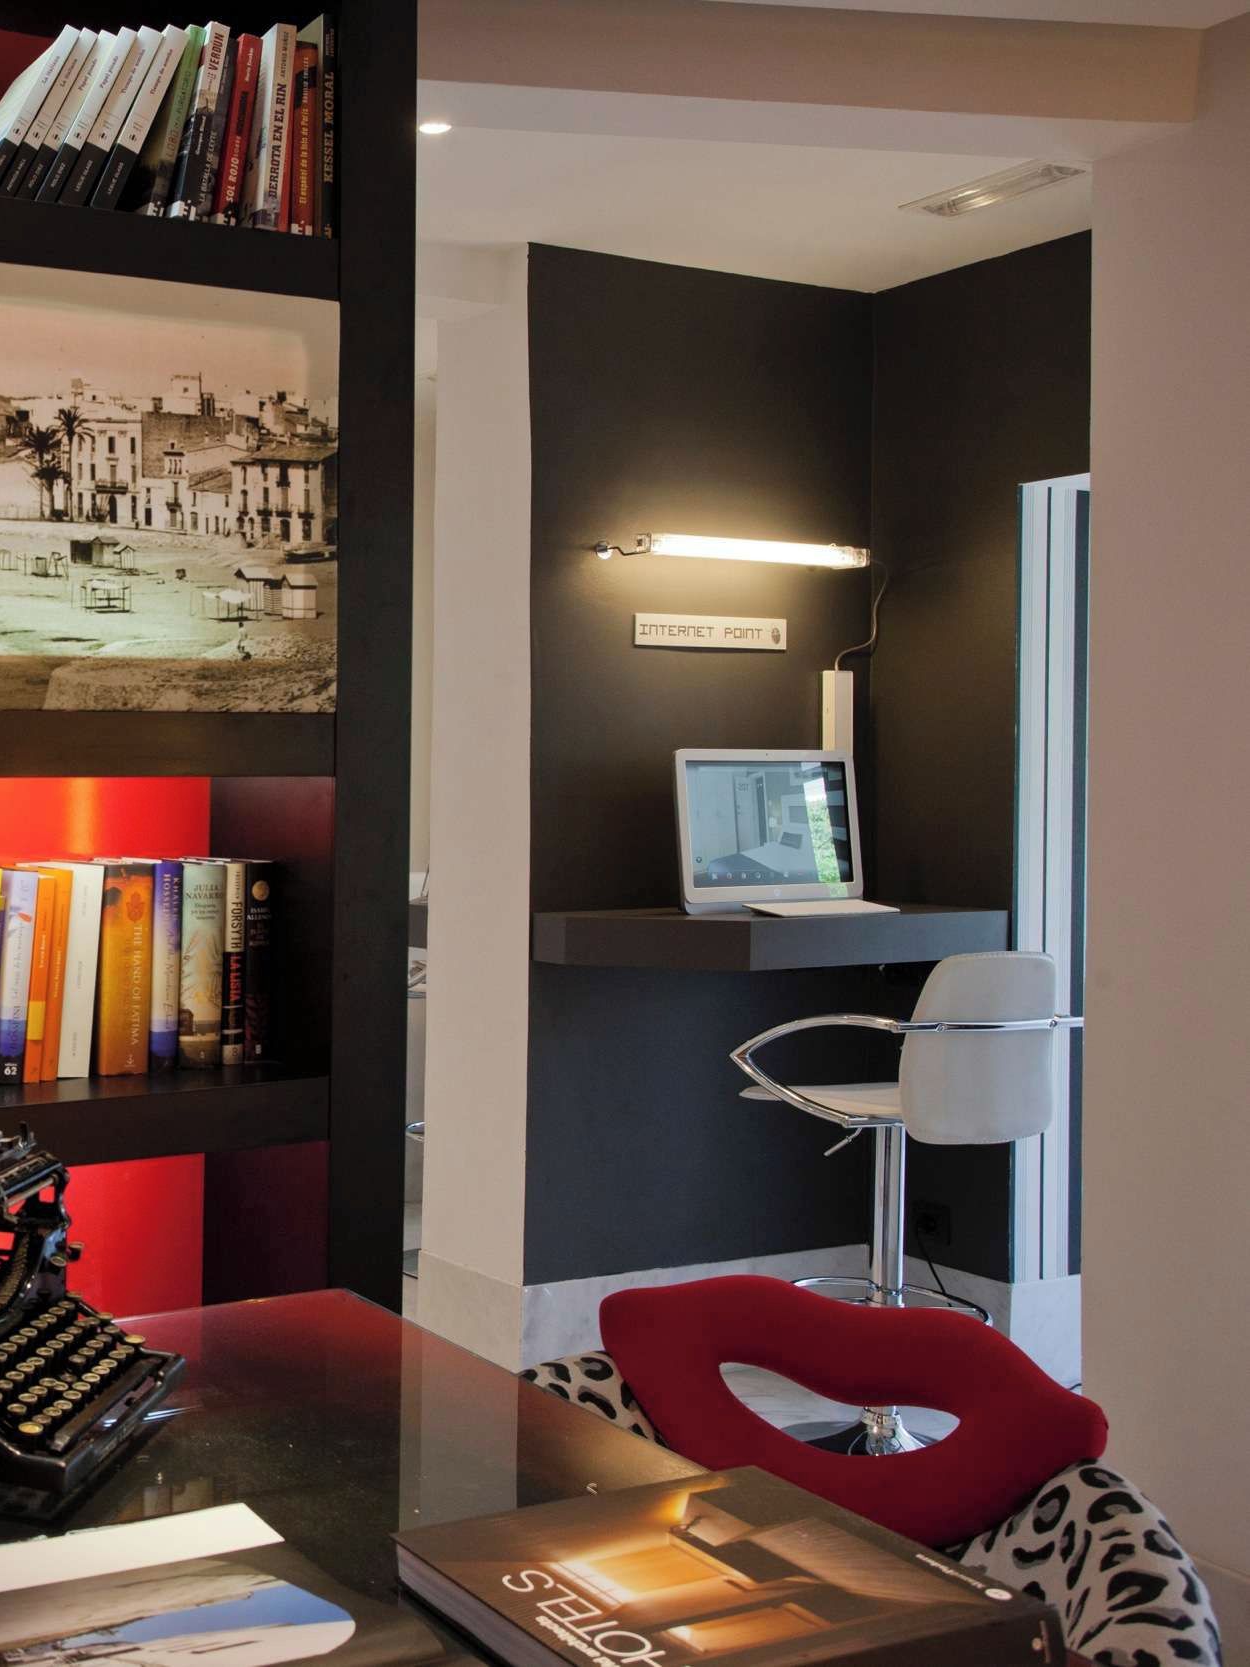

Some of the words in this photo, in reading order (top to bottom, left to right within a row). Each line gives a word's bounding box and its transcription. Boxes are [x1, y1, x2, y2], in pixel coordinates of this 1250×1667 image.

[208, 32, 225, 71] VERDUN
[276, 82, 288, 108] RIN
[323, 71, 335, 129] MORAL
[275, 108, 285, 125] EL
[273, 124, 283, 143] EN
[228, 156, 239, 184] ROJO
[323, 129, 335, 184] KESSEL
[268, 143, 283, 200] DERROTA
[225, 184, 236, 203] SOL
[639, 623, 714, 638] INTERNET
[724, 627, 763, 639] POINT
[133, 925, 143, 946] THE
[230, 901, 244, 949] FORSYTH
[132, 950, 142, 983] HAND
[230, 953, 242, 970] LA
[131, 986, 140, 999] OF
[229, 972, 241, 1001] LISTA
[130, 1003, 140, 1046] FATIMA
[4, 1065, 18, 1076] 62
